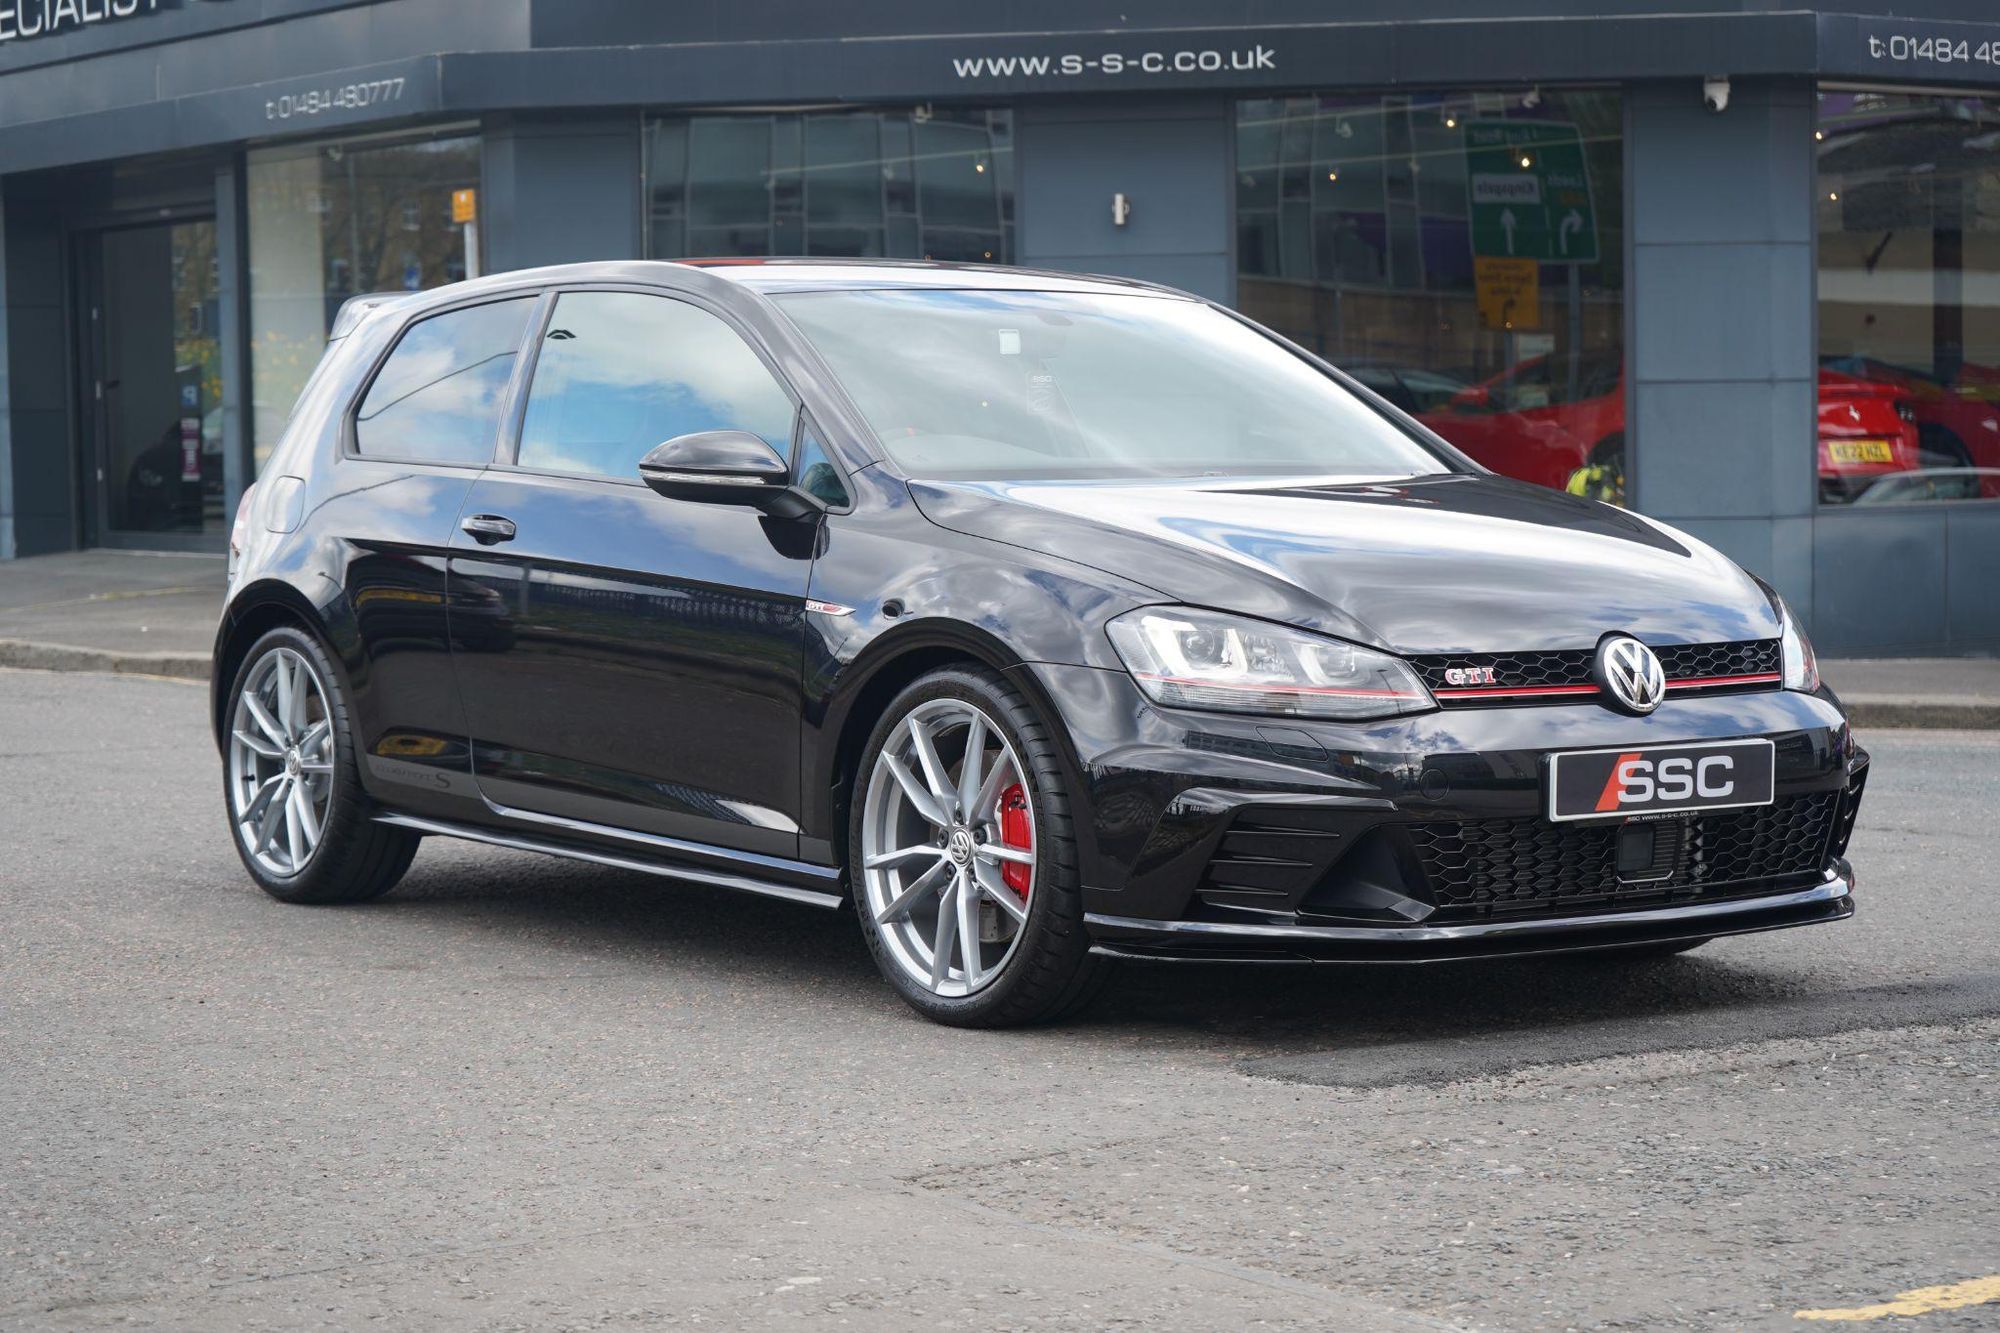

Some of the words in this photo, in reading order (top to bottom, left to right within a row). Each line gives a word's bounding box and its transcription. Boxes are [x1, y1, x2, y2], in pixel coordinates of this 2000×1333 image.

[0, 0, 156, 40] ECIAL
[953, 45, 1277, 77] www.s-s-c.co.uk
[1868, 34, 1969, 63] t:01484
[1445, 668, 1496, 685] GTI
[1617, 755, 1735, 803] SSC
